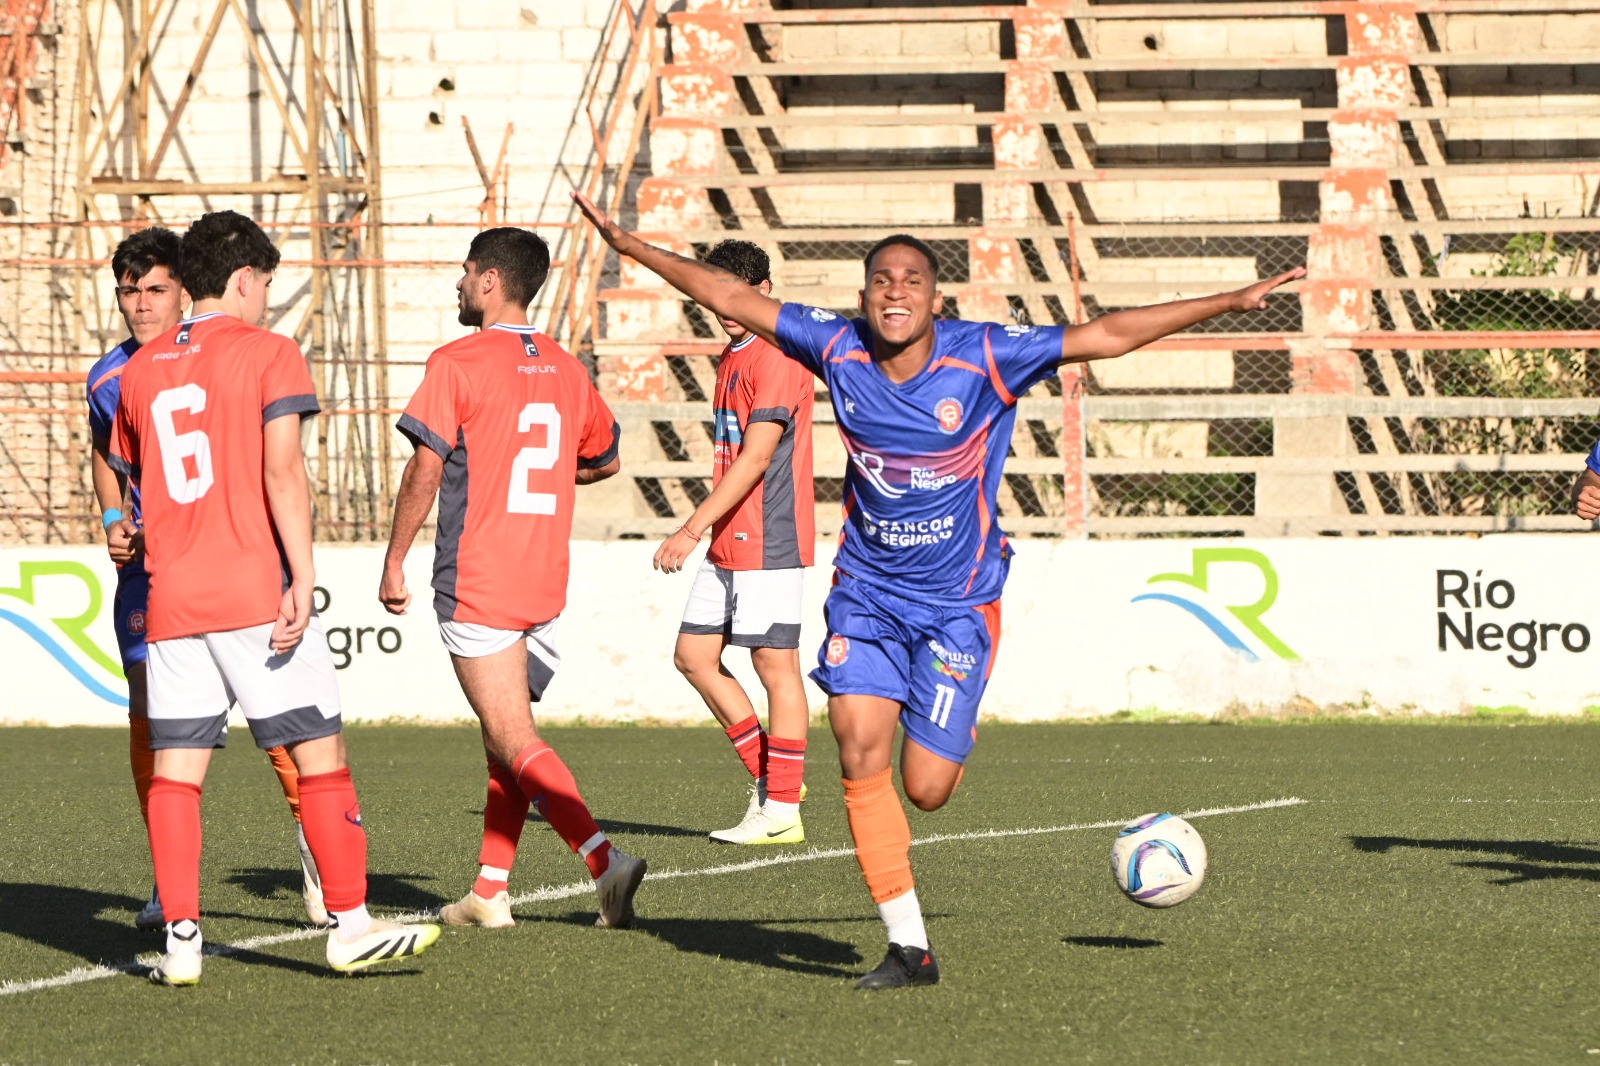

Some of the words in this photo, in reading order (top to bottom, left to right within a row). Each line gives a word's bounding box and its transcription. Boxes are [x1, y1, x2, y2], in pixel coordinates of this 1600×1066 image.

[151, 383, 215, 505] 6
[506, 402, 562, 516] 2
[911, 474, 957, 491] Negro
[1437, 569, 1515, 609] Río
[326, 626, 402, 670] gro
[1437, 611, 1591, 669] Negro
[930, 683, 956, 729] 11
